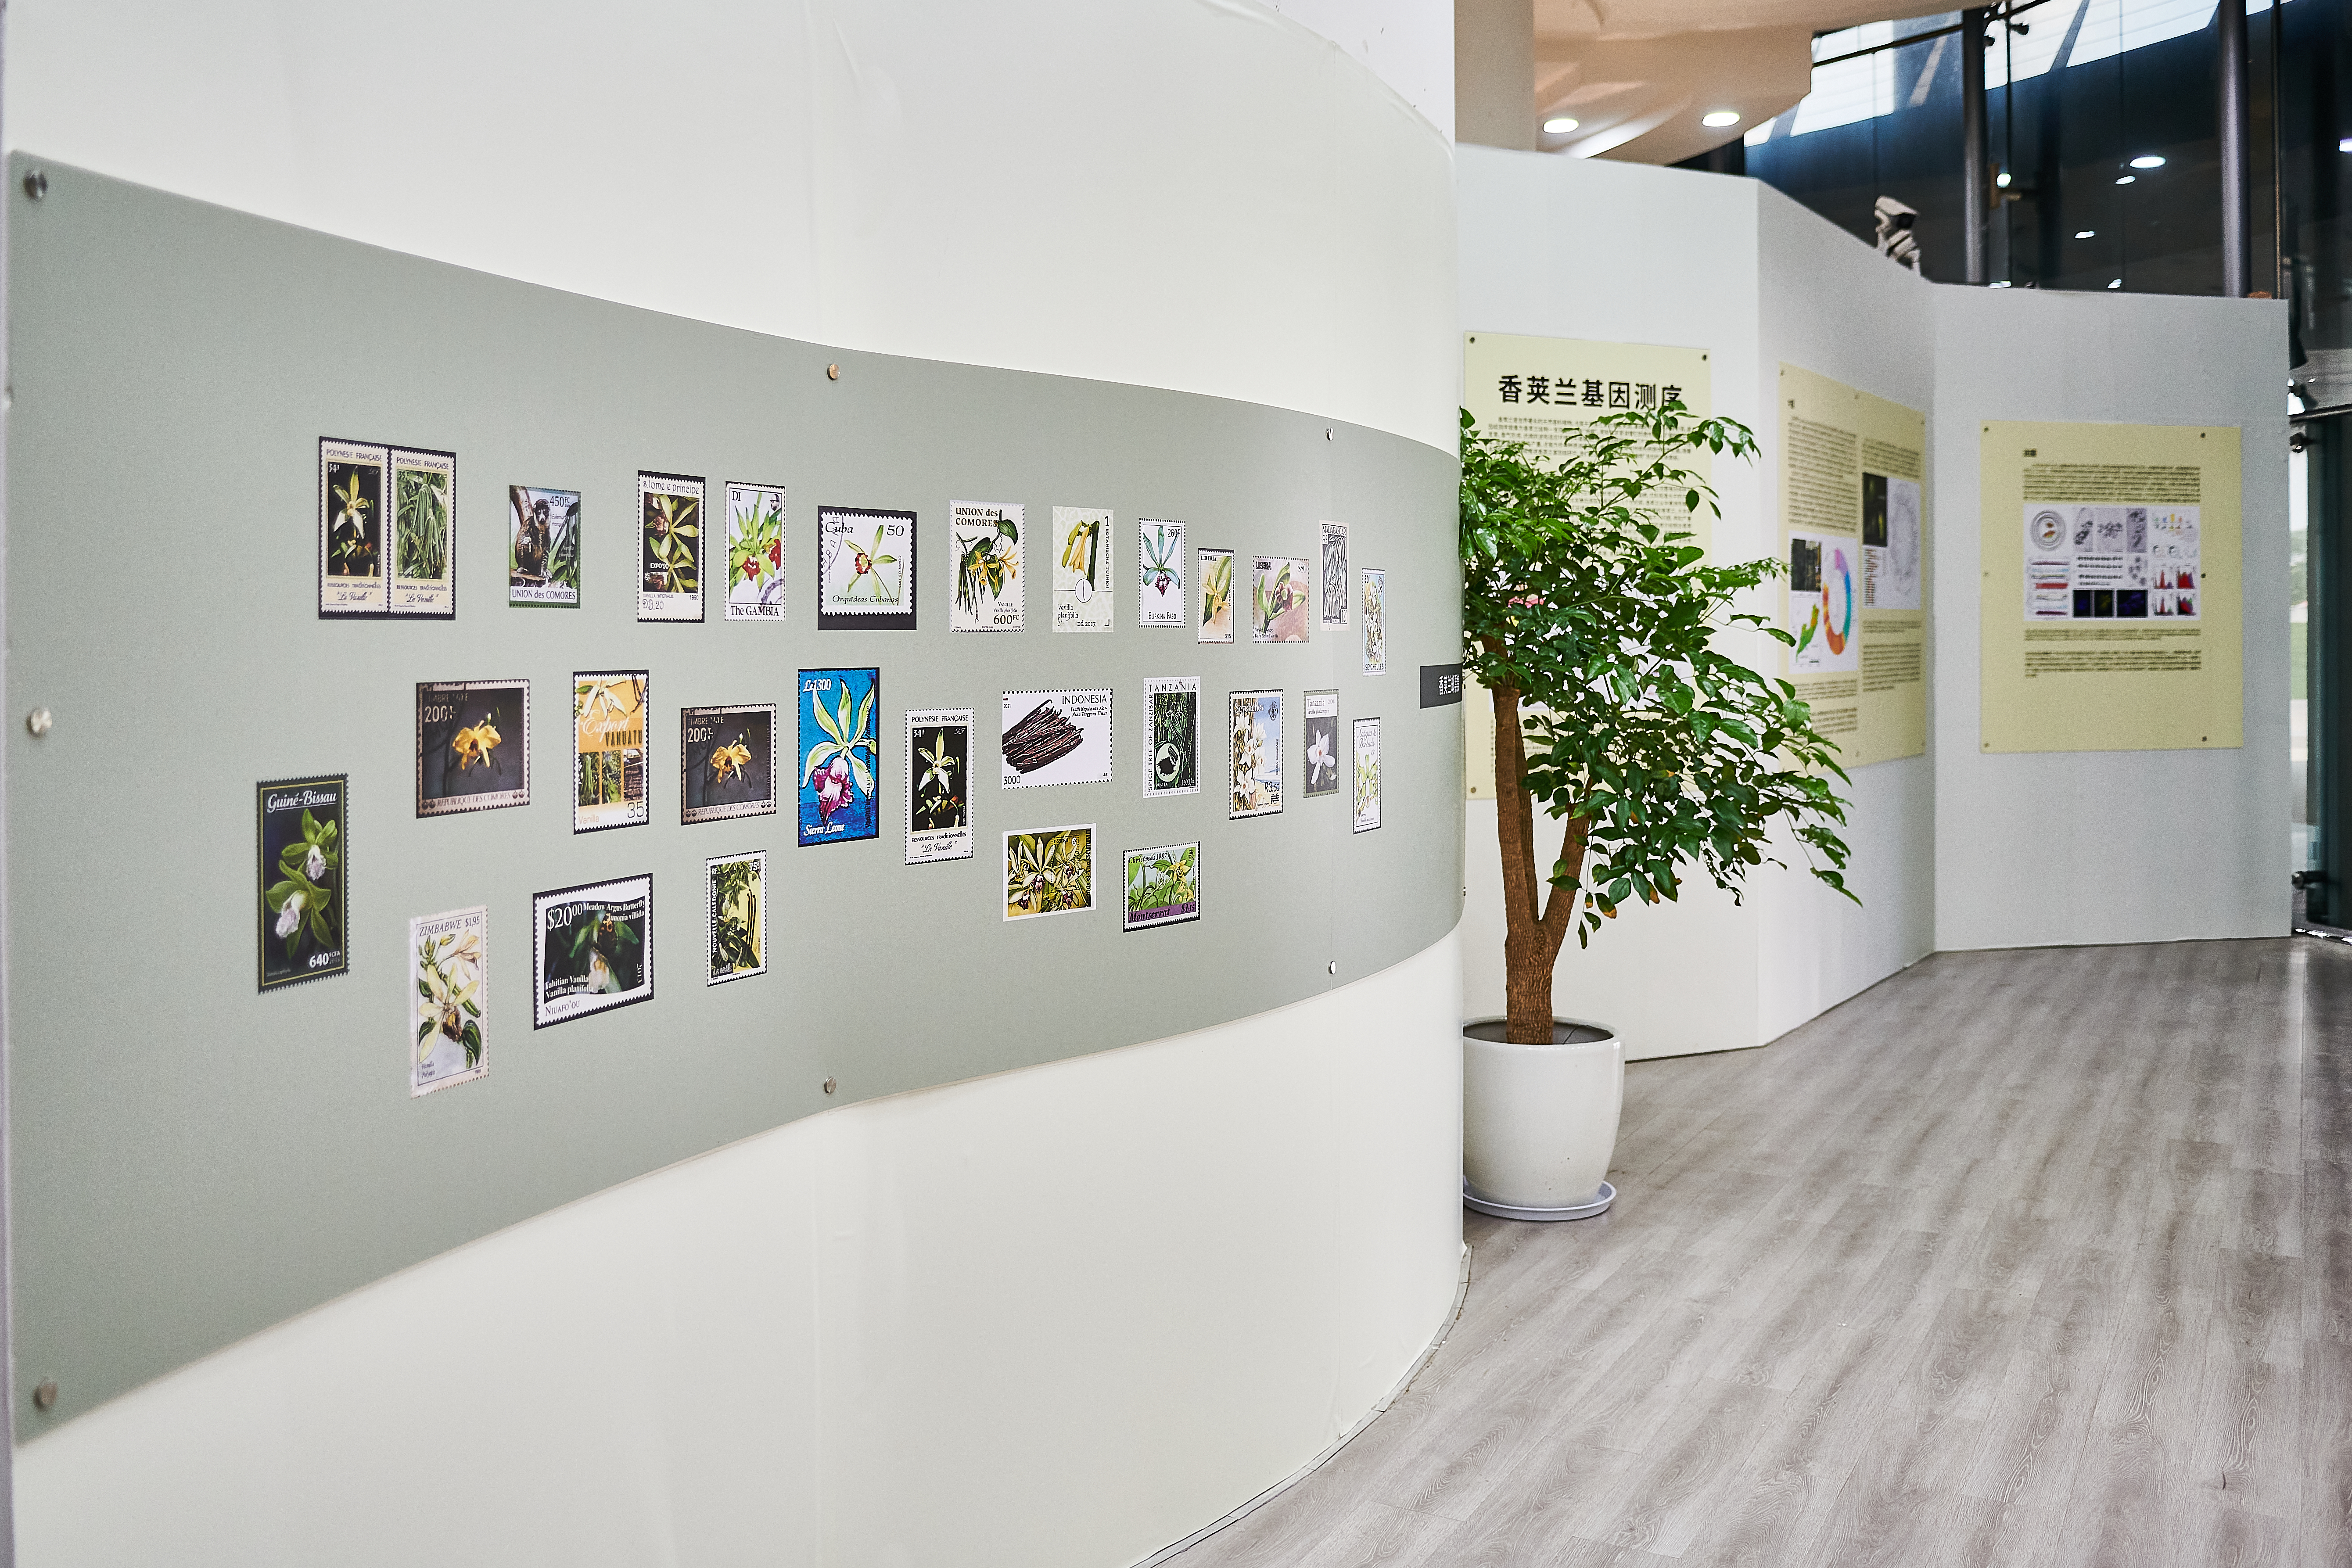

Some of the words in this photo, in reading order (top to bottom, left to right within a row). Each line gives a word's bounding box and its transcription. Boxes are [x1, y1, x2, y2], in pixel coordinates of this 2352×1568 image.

[955, 507, 983, 516] UNION
[986, 508, 998, 517] des
[825, 521, 854, 534] Cuba
[955, 518, 998, 527] COMORES
[887, 525, 904, 537] 50
[1322, 525, 1347, 535] MADAGASCAR
[512, 589, 533, 598] UNION
[534, 590, 544, 599] des
[546, 591, 576, 600] COMORES
[832, 595, 868, 604] Orquídeas
[730, 606, 744, 616] The
[746, 606, 779, 616] GAMBIA
[1149, 683, 1196, 693] TANZANIA
[1062, 694, 1107, 705] INDONESIA
[1307, 698, 1325, 707] Tanzania
[1235, 702, 1264, 715] Seychelles
[582, 709, 630, 743] Export
[605, 729, 643, 748] VANUATU
[1003, 775, 1020, 785] 3000
[266, 789, 338, 813] Guiné-Bissau
[627, 801, 644, 819] 35
[578, 814, 600, 825] Vanilla
[803, 824, 825, 836] Sierra
[825, 822, 845, 834] Leone
[1128, 854, 1156, 864] Christmas
[583, 902, 606, 911] Meadow
[606, 902, 622, 912] Argus
[623, 899, 645, 911] Butterfly
[607, 913, 628, 922] Junonia
[629, 909, 645, 920] villida
[1129, 908, 1171, 922] Montserrat
[420, 920, 461, 936] ZIMBABWE
[309, 952, 329, 969] 640
[545, 978, 568, 990] Tahitian
[569, 975, 589, 983] Vanilla
[546, 988, 566, 999] Vanilla
